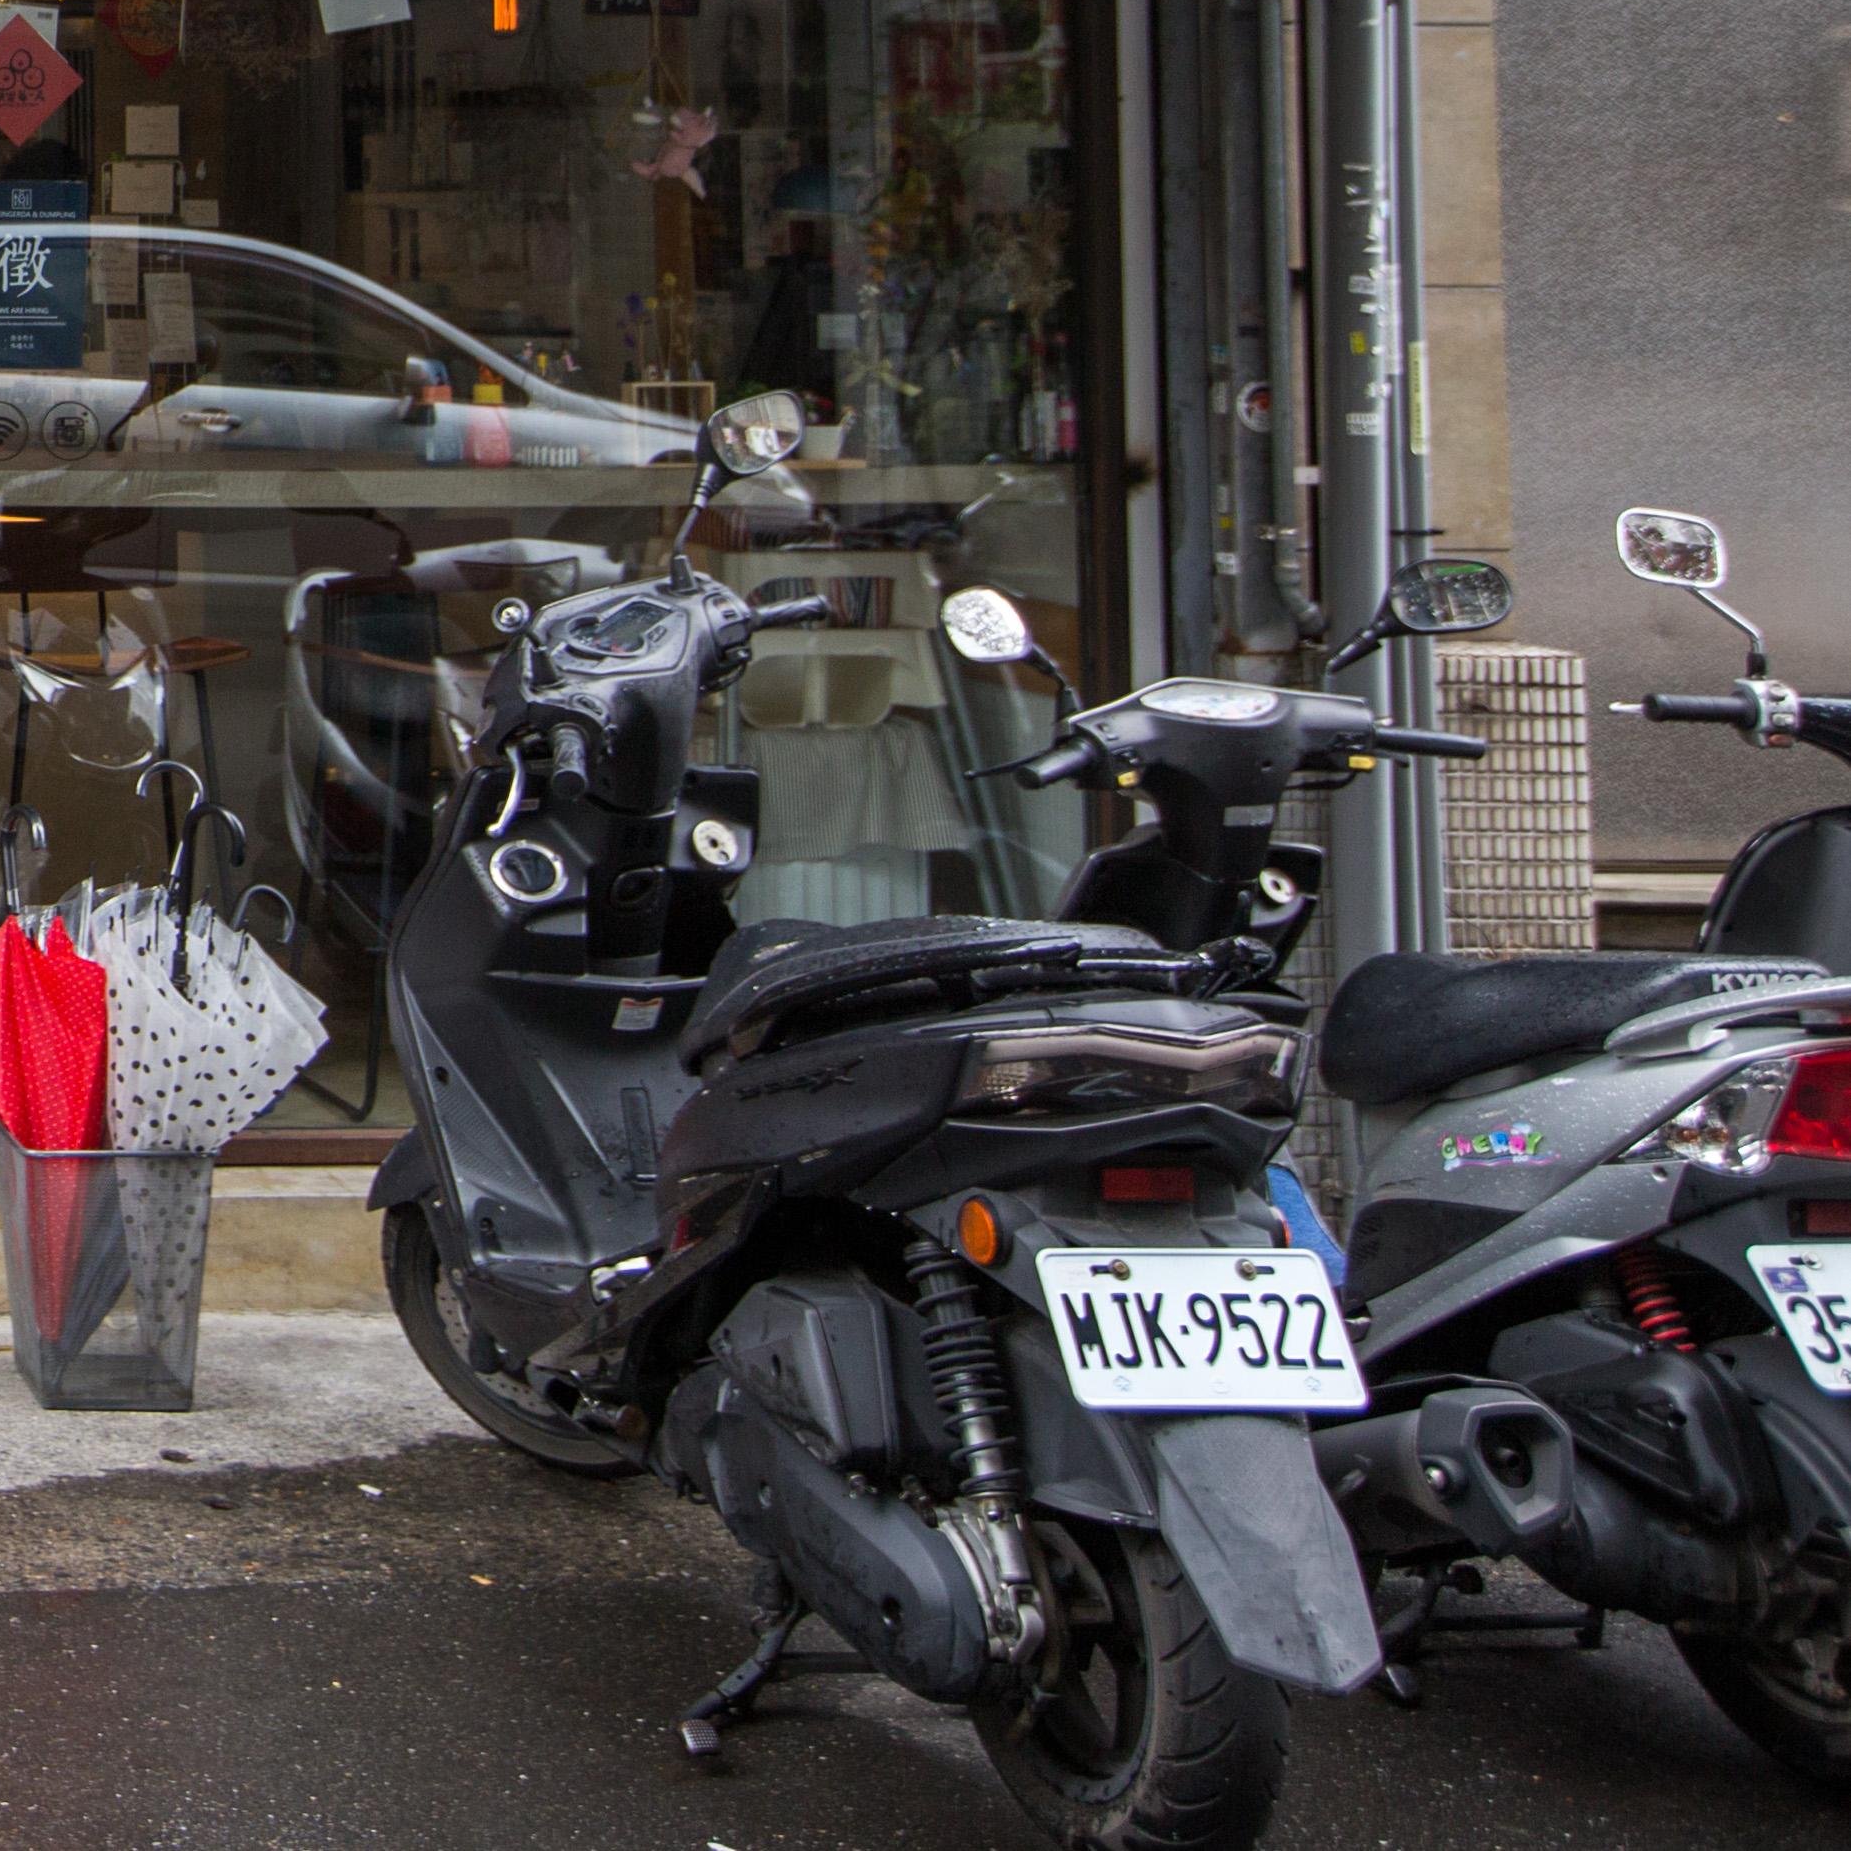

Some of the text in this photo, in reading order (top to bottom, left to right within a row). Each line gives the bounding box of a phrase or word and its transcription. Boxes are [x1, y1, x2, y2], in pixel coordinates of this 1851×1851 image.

[10, 307, 24, 315] ARE
[24, 307, 50, 315] HIRING
[1059, 1291, 1346, 1371] MJK-9522
